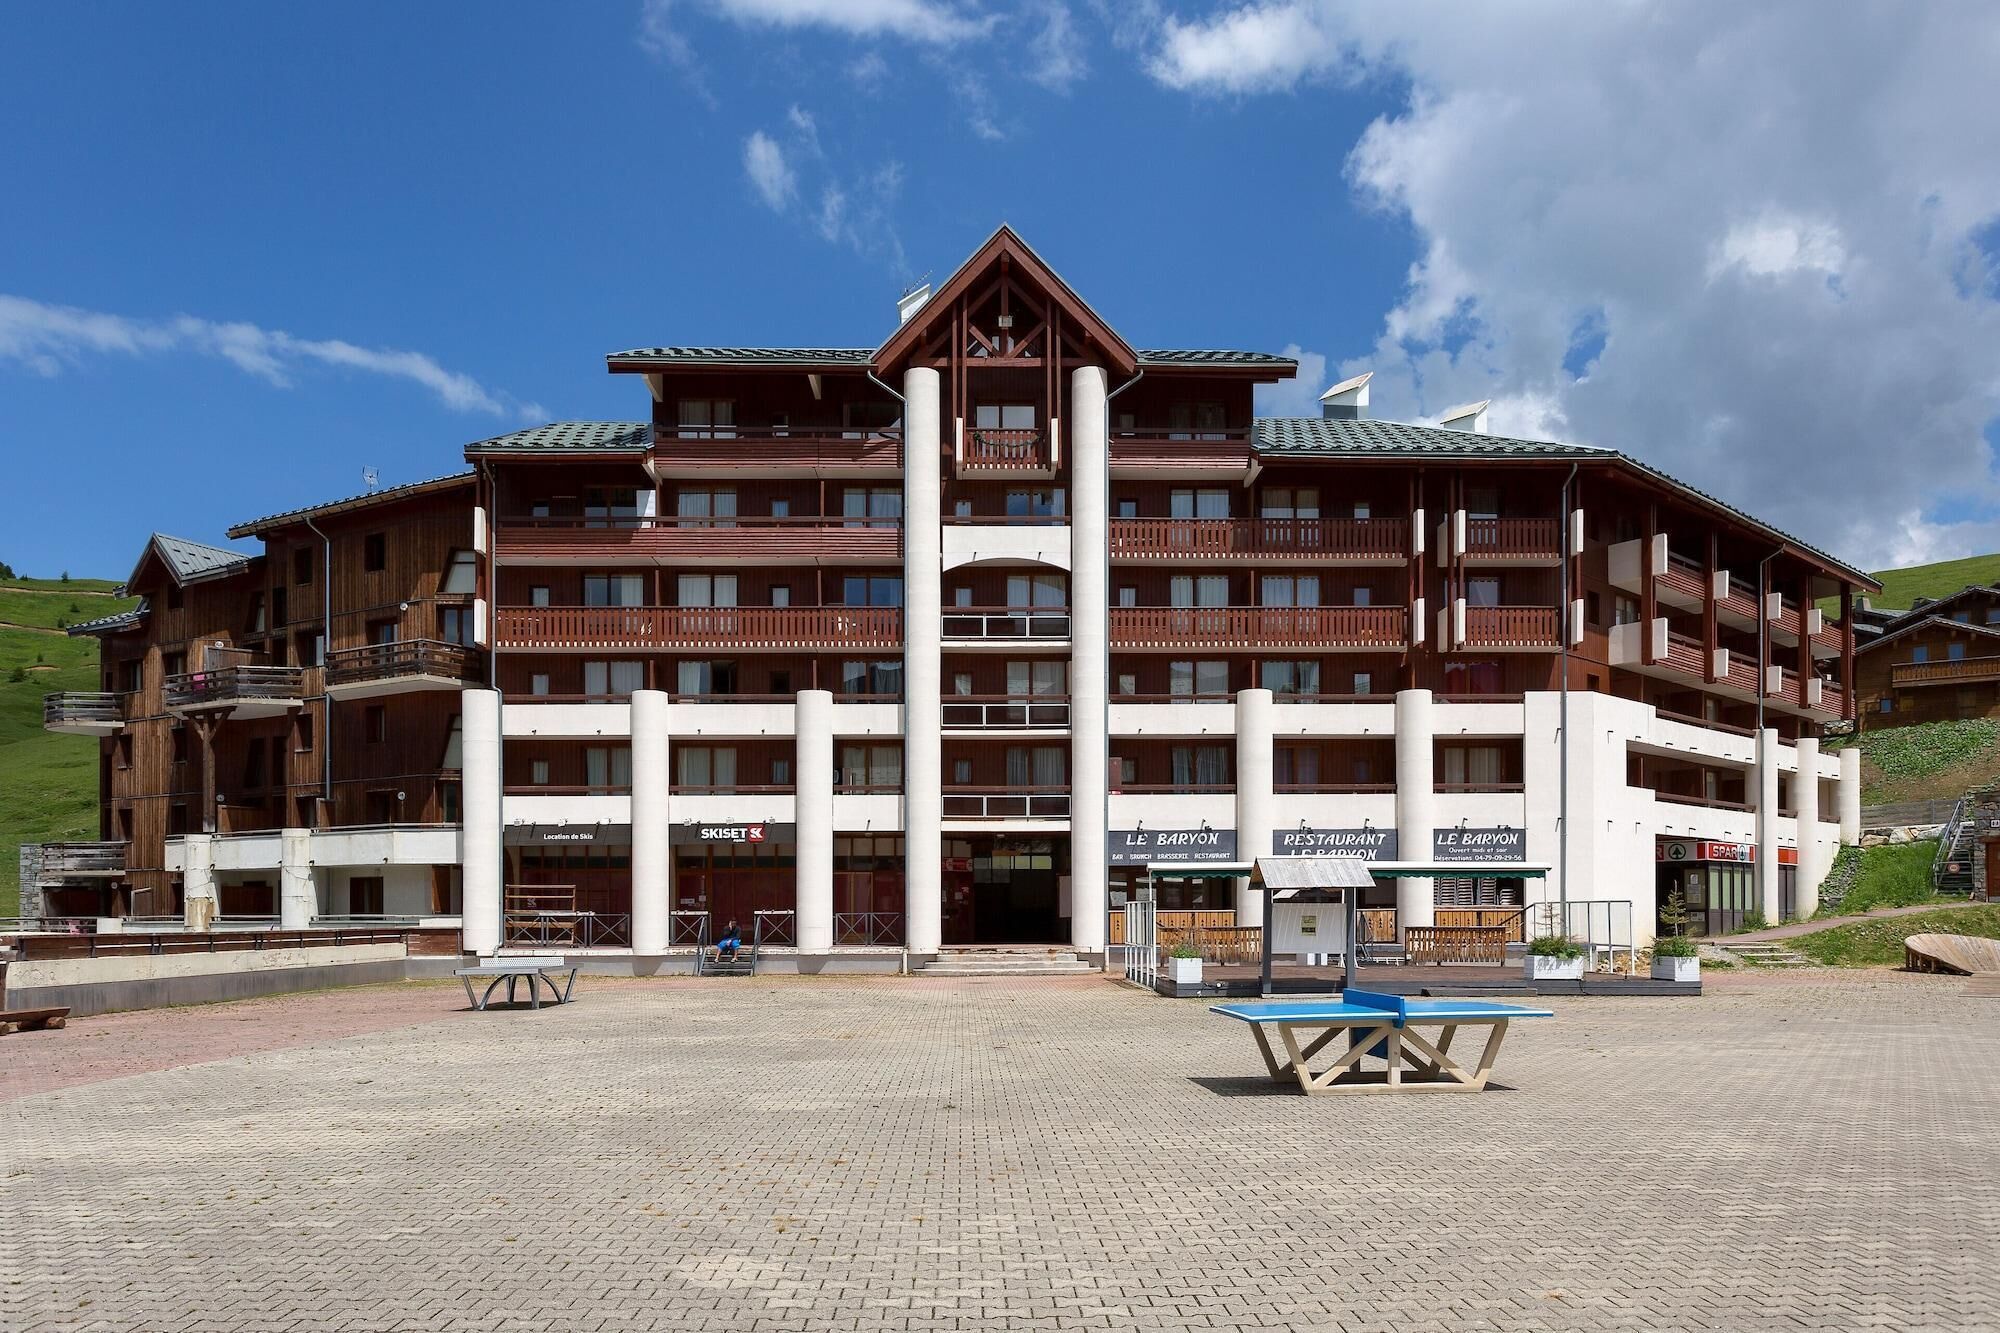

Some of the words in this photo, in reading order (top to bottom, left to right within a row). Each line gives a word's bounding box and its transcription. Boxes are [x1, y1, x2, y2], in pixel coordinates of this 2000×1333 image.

[701, 827, 748, 839] SKISET
[1126, 833, 1148, 846] LE
[1156, 832, 1220, 846] BARYON
[1283, 833, 1387, 846] RESTAURANT
[1437, 833, 1458, 845] LE
[1461, 832, 1519, 845] BARYON
[1157, 852, 1190, 860] BRASSERIE
[1194, 852, 1231, 860] RESTAURANT
[1712, 845, 1738, 859] SPAR
